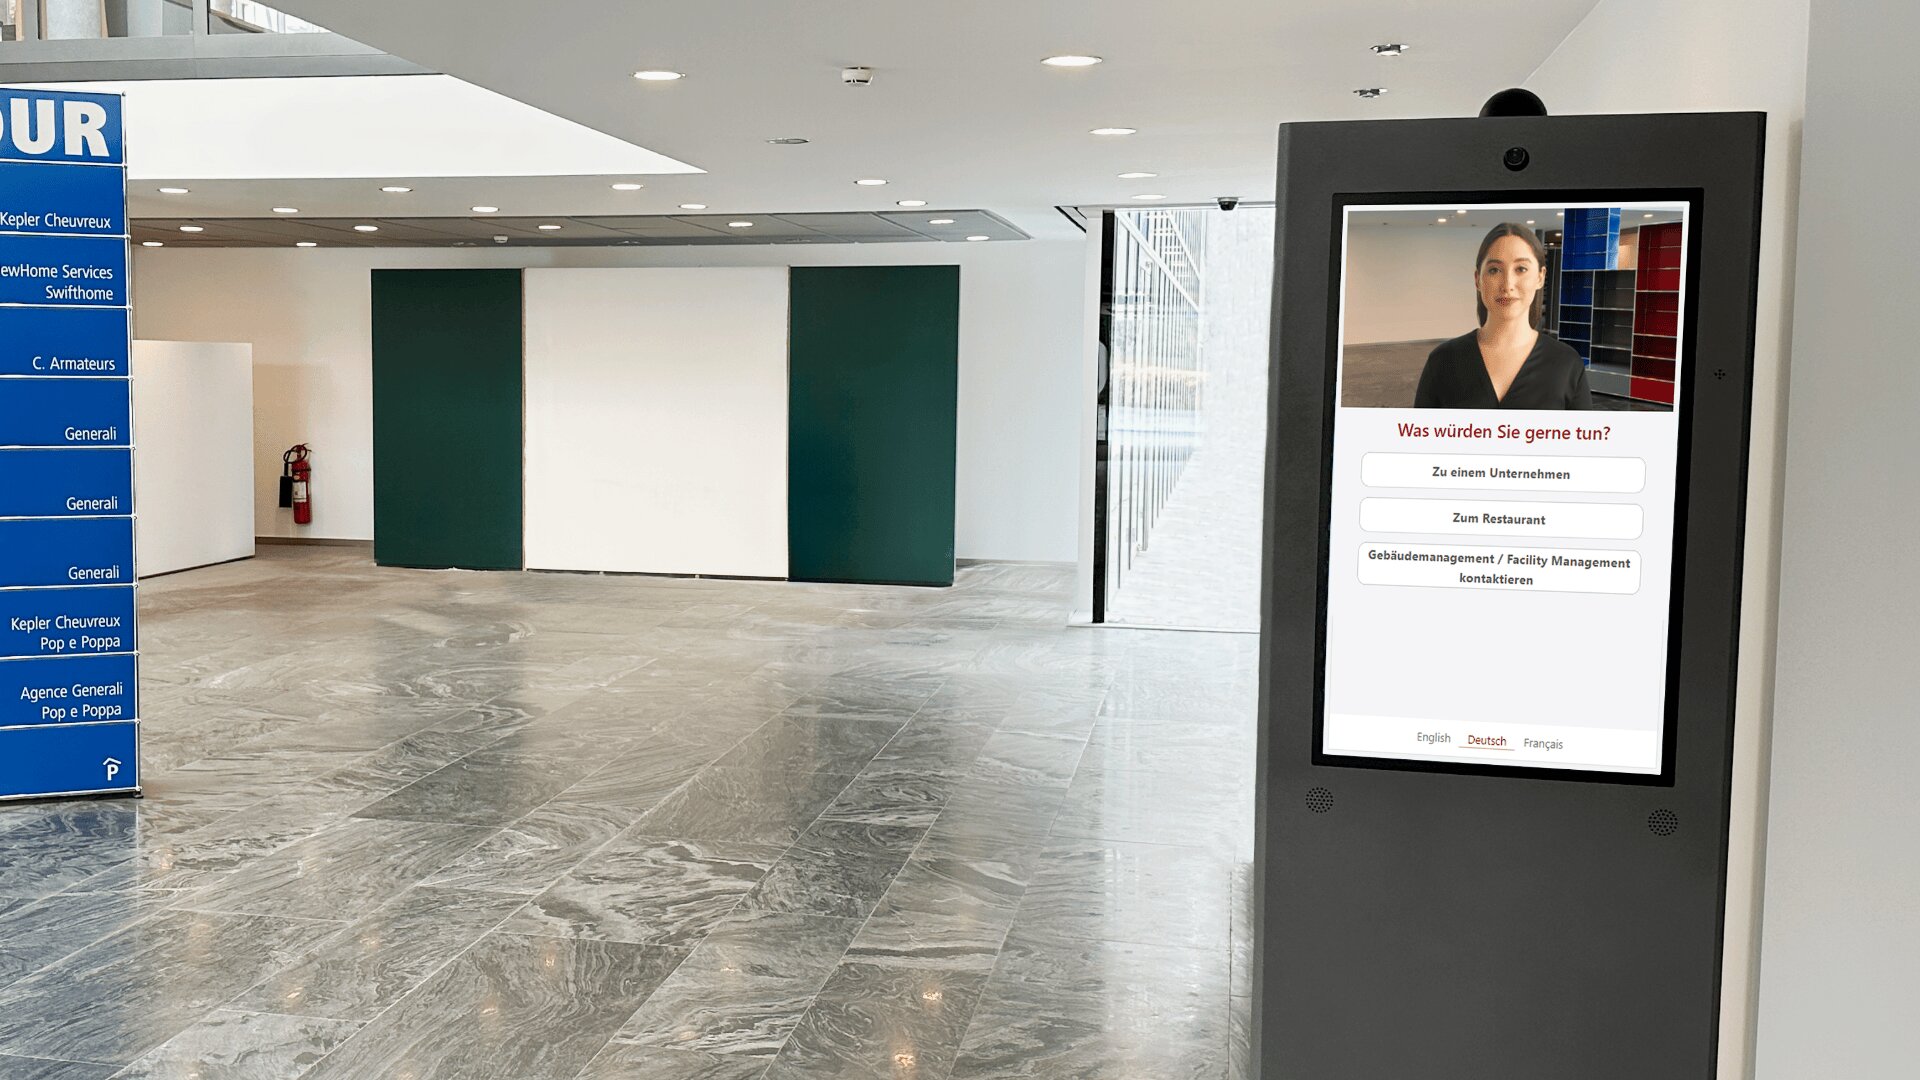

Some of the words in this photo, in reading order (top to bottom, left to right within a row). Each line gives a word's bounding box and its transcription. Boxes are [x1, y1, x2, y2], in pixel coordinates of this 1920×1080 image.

[0, 98, 110, 157] UR
[0, 212, 40, 229] Kepler
[45, 213, 111, 228] Cheuvreux
[63, 265, 113, 279] Services
[46, 285, 113, 300] Swifthome
[33, 357, 44, 369] C.
[50, 357, 115, 370] Armateurs
[65, 426, 116, 440] Generali
[1398, 423, 1429, 437] Was
[1434, 423, 1492, 438] würden
[1497, 424, 1520, 439] Sie
[1525, 429, 1571, 444] gerne
[1576, 426, 1611, 440] tun?
[1432, 466, 1447, 477] Zu
[1450, 467, 1485, 477] einem
[1490, 468, 1570, 479] Unternehmen
[67, 496, 117, 510] Generali
[1453, 513, 1478, 523] Zum
[1483, 513, 1545, 525] Restaurant
[1368, 550, 1494, 565] Gebäudemanagement
[1497, 554, 1503, 565] /
[1507, 554, 1548, 568] Facility
[1552, 556, 1630, 569] Management
[69, 565, 119, 579] Generali
[1460, 573, 1533, 585] kontaktieren
[12, 616, 51, 633] Kepler
[56, 615, 120, 629] Cheuvreux
[41, 637, 64, 652] Pop
[69, 639, 76, 648] e
[82, 636, 120, 651] Poppa
[21, 687, 67, 702] Agence
[72, 682, 122, 697] Generali
[43, 707, 65, 721] Pop
[71, 708, 77, 717] e
[83, 705, 122, 720] Poppa
[1417, 732, 1450, 744] English
[1468, 735, 1506, 746] Deutsch
[1524, 738, 1563, 751] Français
